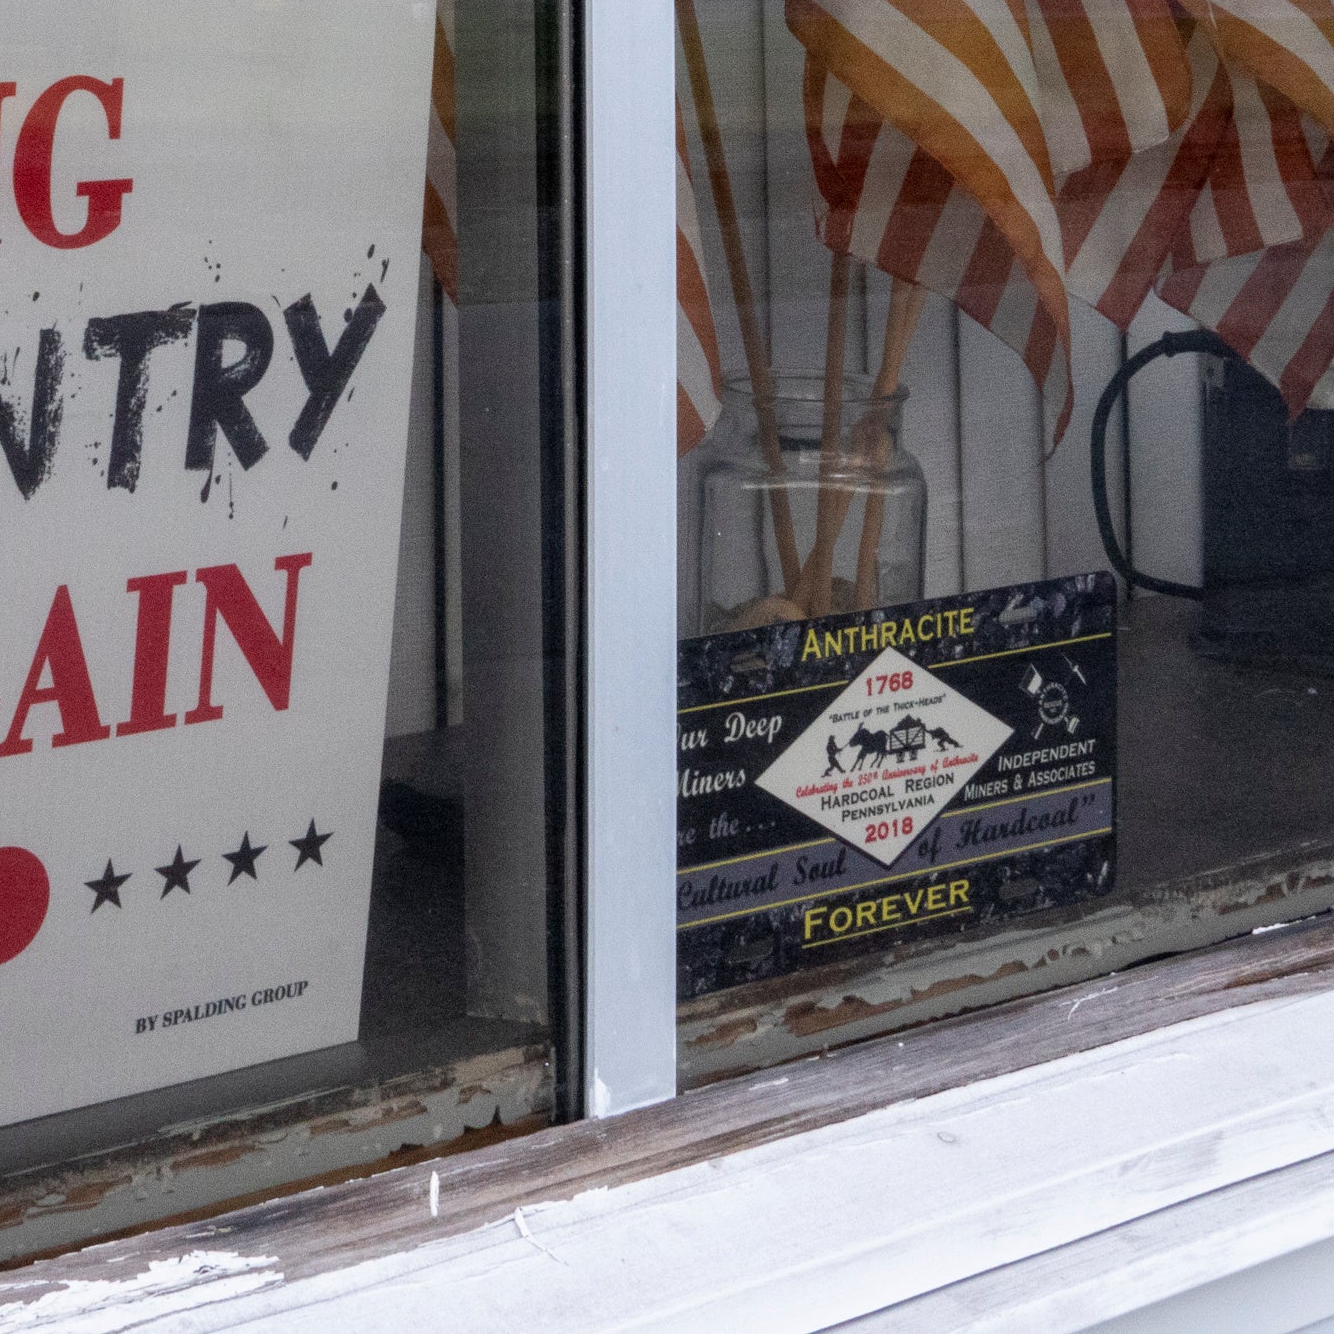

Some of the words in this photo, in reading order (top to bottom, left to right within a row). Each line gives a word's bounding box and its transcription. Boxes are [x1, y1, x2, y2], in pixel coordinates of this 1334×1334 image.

[801, 607, 975, 662] ANTHRACITE
[866, 670, 914, 697] 1768
[724, 711, 782, 744] Deep
[998, 738, 1096, 773] INDEPENDENT
[820, 785, 895, 811] HARDCOAL
[905, 772, 955, 794] REGION
[964, 779, 1008, 802] MINERS
[1013, 774, 1023, 791] &
[1028, 761, 1096, 788] ASSOCIATES
[841, 794, 935, 823] PENNSYLVANIA
[865, 816, 914, 844] 2018
[792, 850, 846, 888] Soul
[918, 825, 942, 864] of
[802, 879, 970, 941] FOREVER
[135, 1015, 158, 1034] BY
[162, 994, 247, 1028] SPALDING
[251, 980, 309, 1006] GROUP
